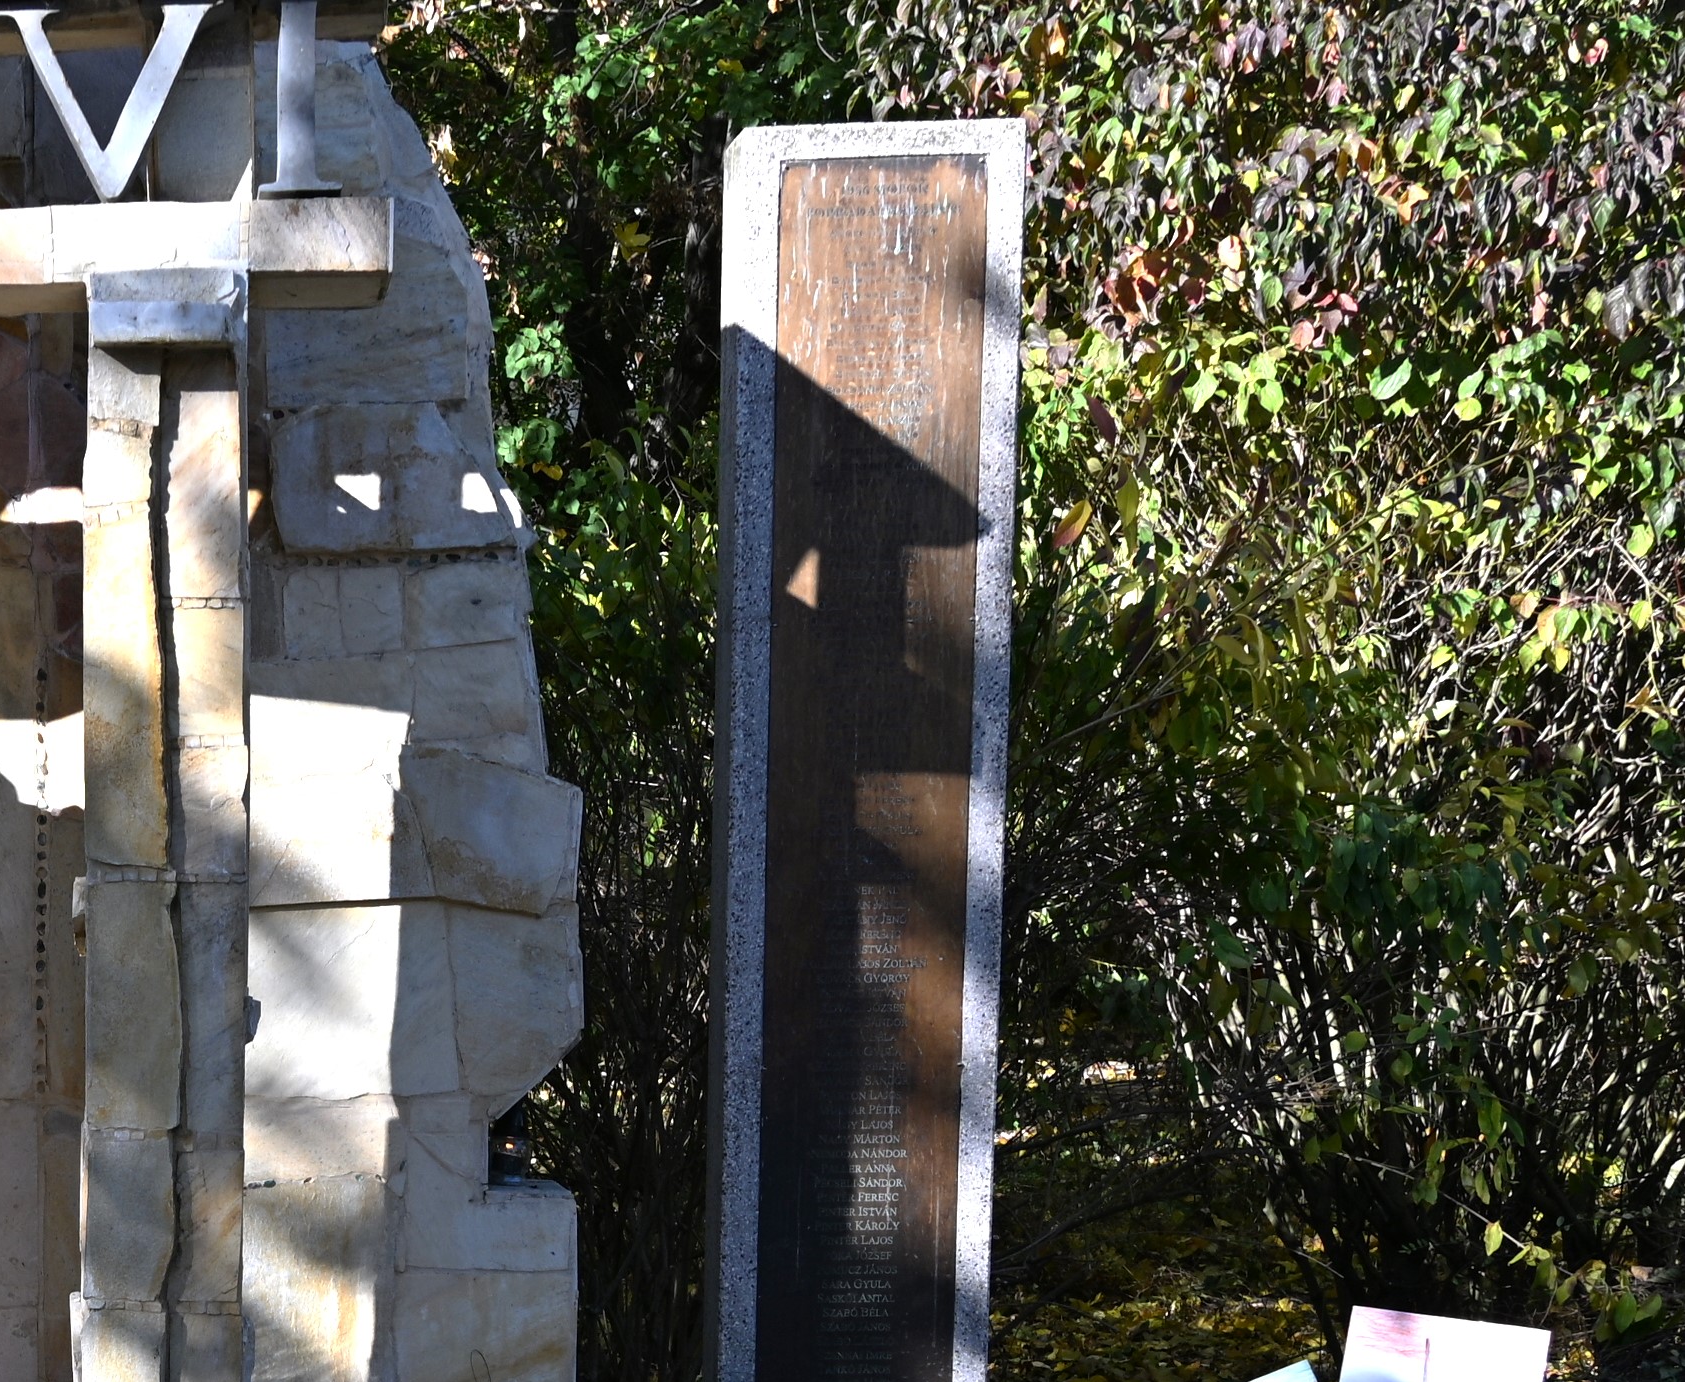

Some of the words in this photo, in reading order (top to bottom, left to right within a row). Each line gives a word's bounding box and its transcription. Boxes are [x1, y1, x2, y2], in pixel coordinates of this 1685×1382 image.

[863, 973, 910, 984] GYÖRGY
[868, 1104, 902, 1115] PÉTER
[860, 1119, 894, 1129] LAJOS
[853, 1133, 900, 1144] MÁRTON
[861, 1147, 907, 1159] NÁNDOR
[865, 1163, 896, 1174] ANNA
[859, 1176, 903, 1188] SÁNDOR
[858, 1191, 899, 1202] FERENC
[858, 1205, 897, 1216] ISTVÁN
[855, 1219, 900, 1231] KÁROLY
[861, 1234, 893, 1245] LAJOS
[855, 1248, 893, 1261] JÓZSEF
[864, 1263, 898, 1275] JÁNOS
[853, 1279, 892, 1289] GYULA
[858, 1293, 896, 1303] ANTAL
[861, 1307, 889, 1317] BÉLA
